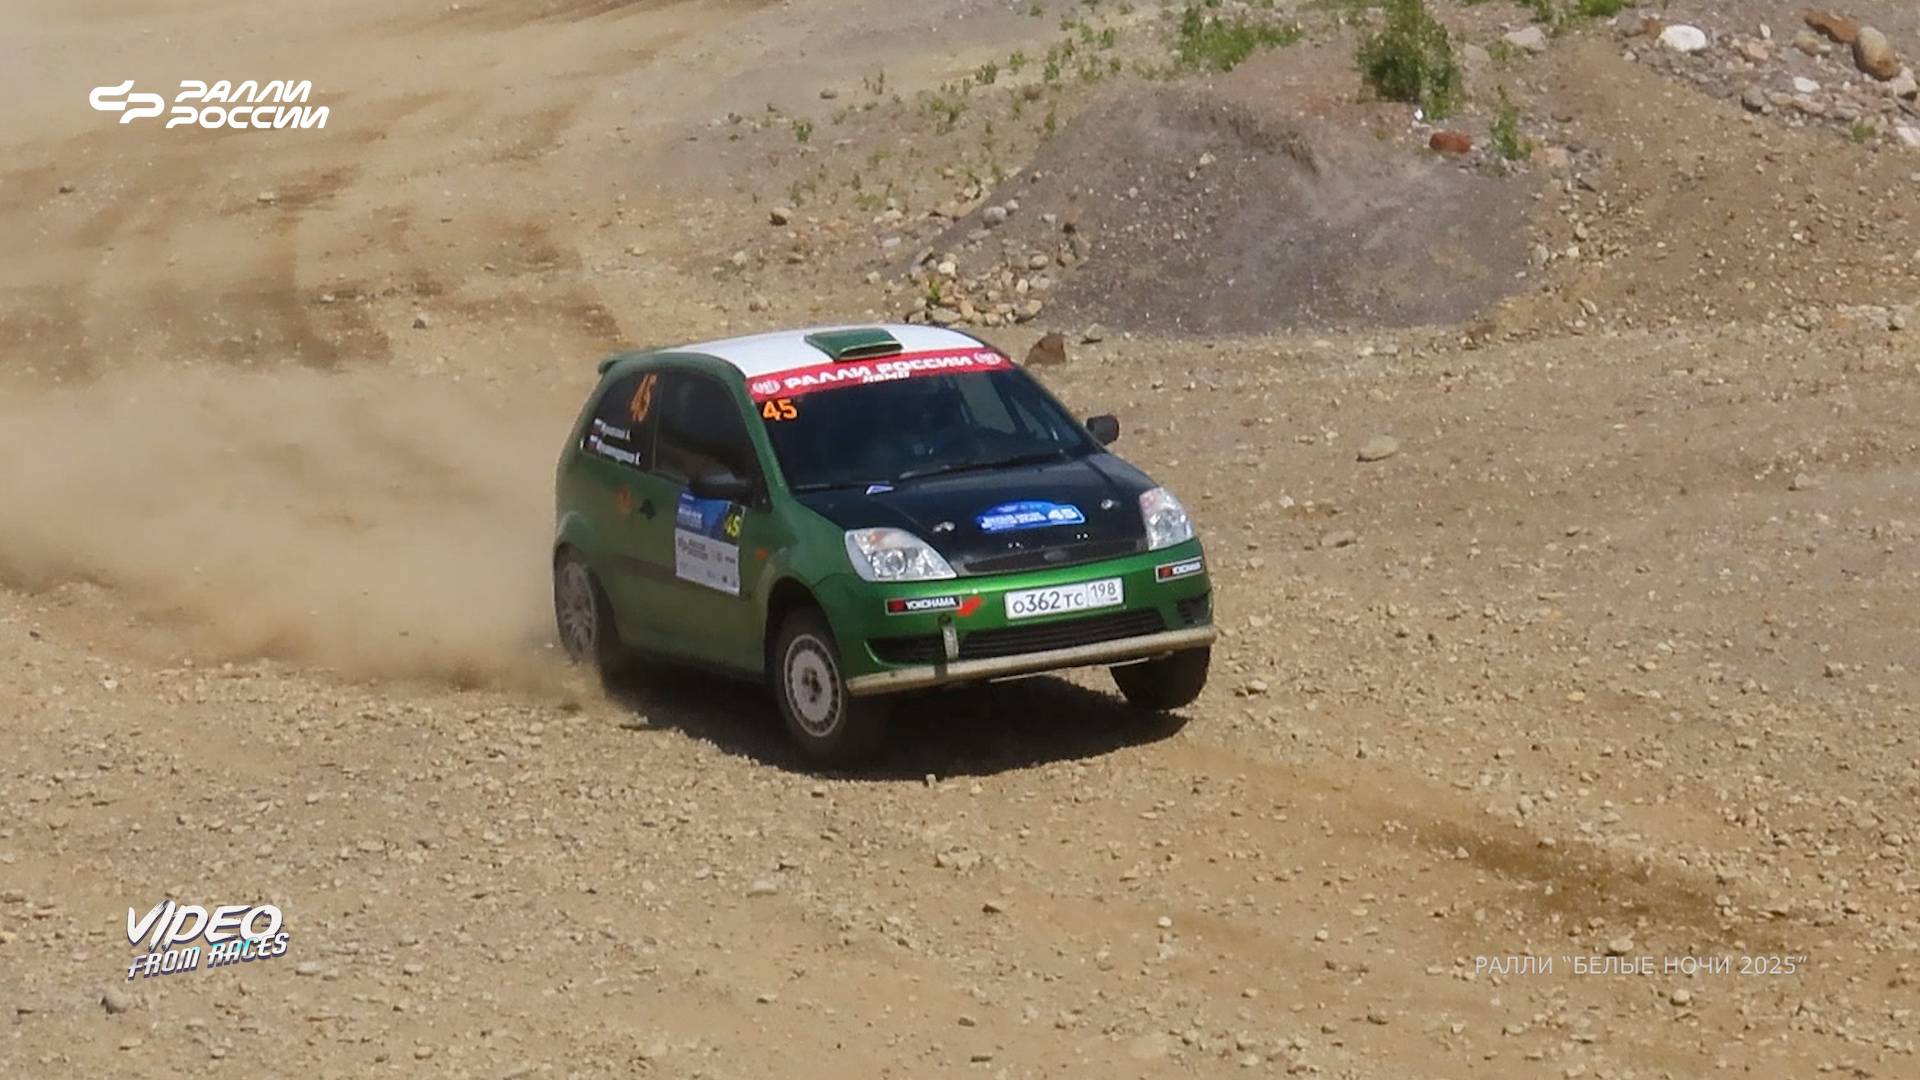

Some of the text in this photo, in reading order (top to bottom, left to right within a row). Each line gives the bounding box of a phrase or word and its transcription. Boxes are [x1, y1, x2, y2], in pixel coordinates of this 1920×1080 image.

[783, 365, 872, 389] РАЛЛИ
[876, 356, 974, 374] РОССИИ
[629, 372, 658, 423] 45
[762, 399, 798, 422] 45
[1090, 582, 1117, 599] 198
